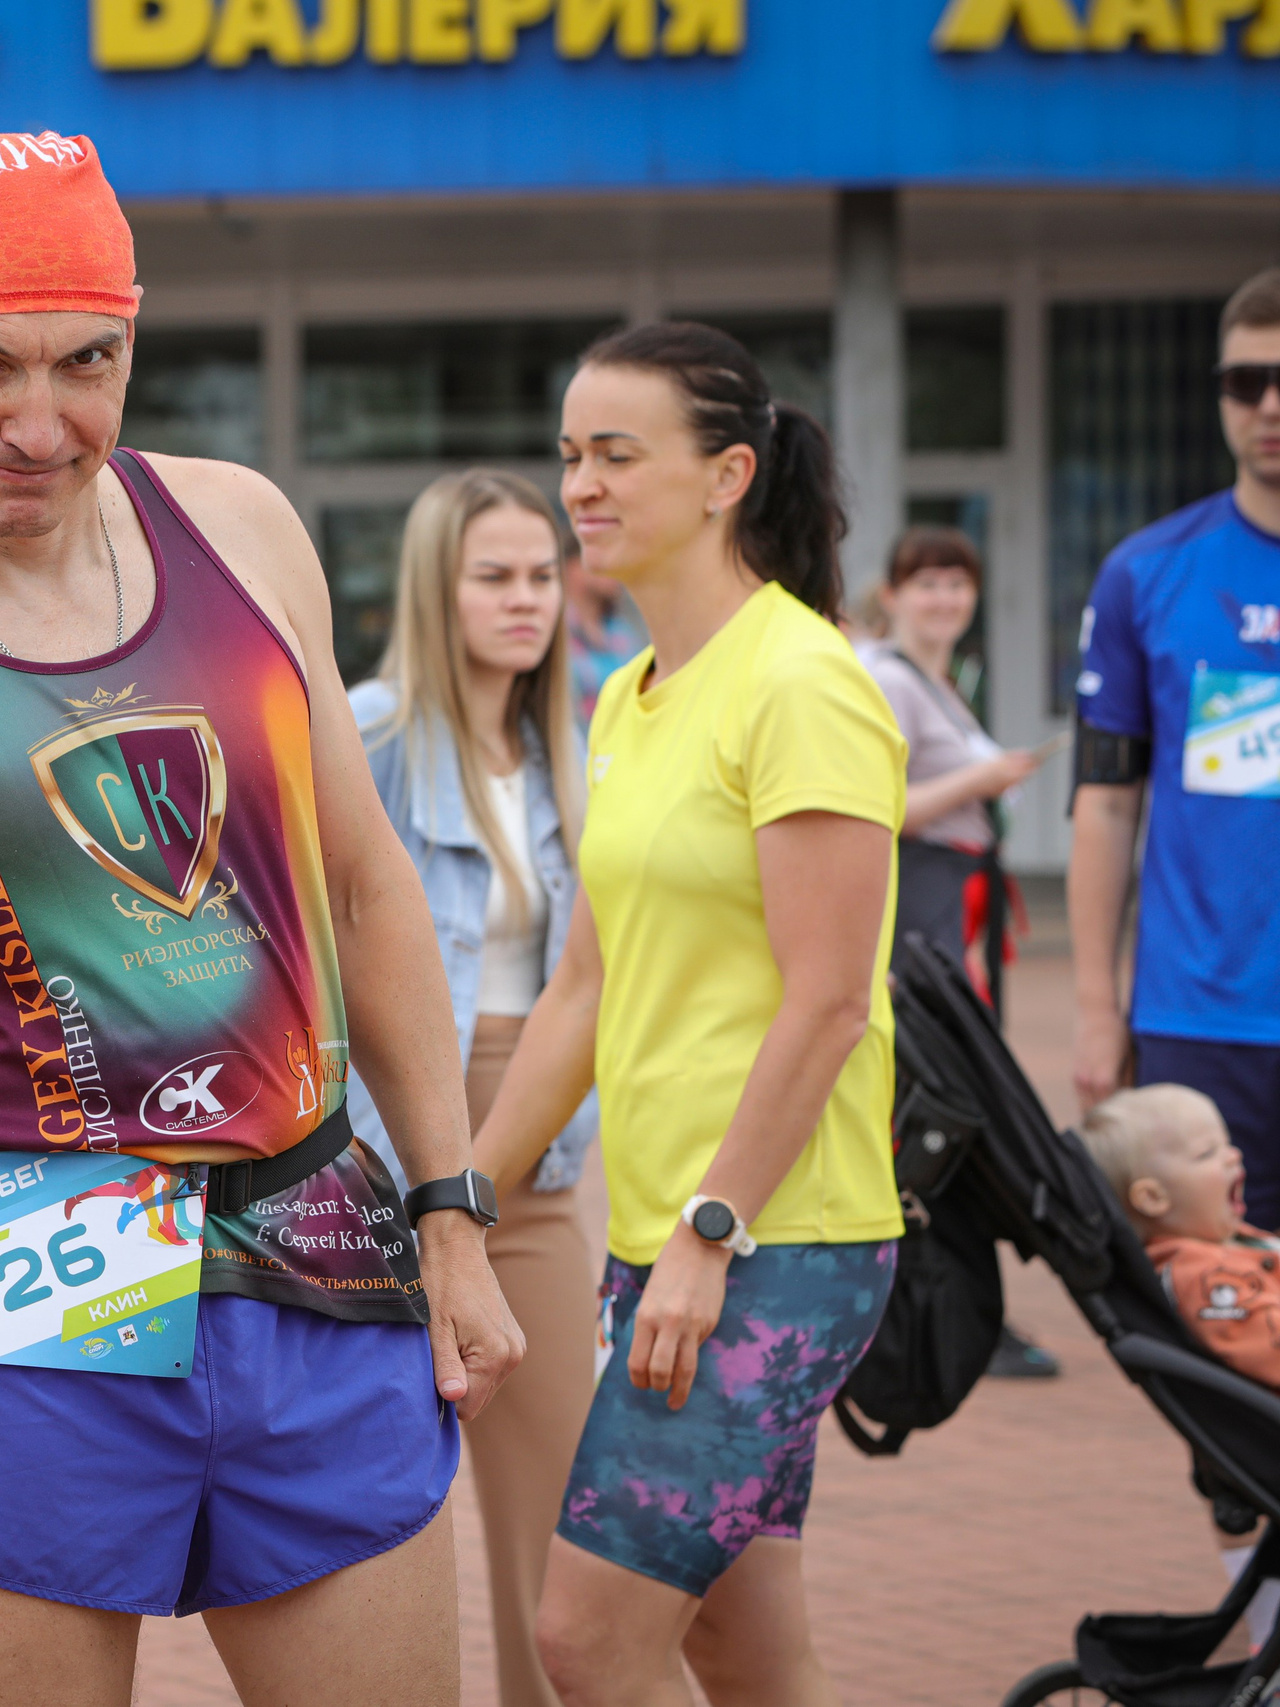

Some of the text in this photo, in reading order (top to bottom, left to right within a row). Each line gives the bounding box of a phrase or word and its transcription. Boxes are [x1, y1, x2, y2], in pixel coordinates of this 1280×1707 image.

[121, 922, 271, 971] РИЭЛТОРСКАЯ
[162, 954, 254, 989] ЗАЩИТА
[22, 1038, 86, 1153] GEY
[166, 1111, 228, 1131] СИСТЕМЫ
[278, 1226, 336, 1254] Сергей
[88, 1287, 149, 1322] КЛИН
